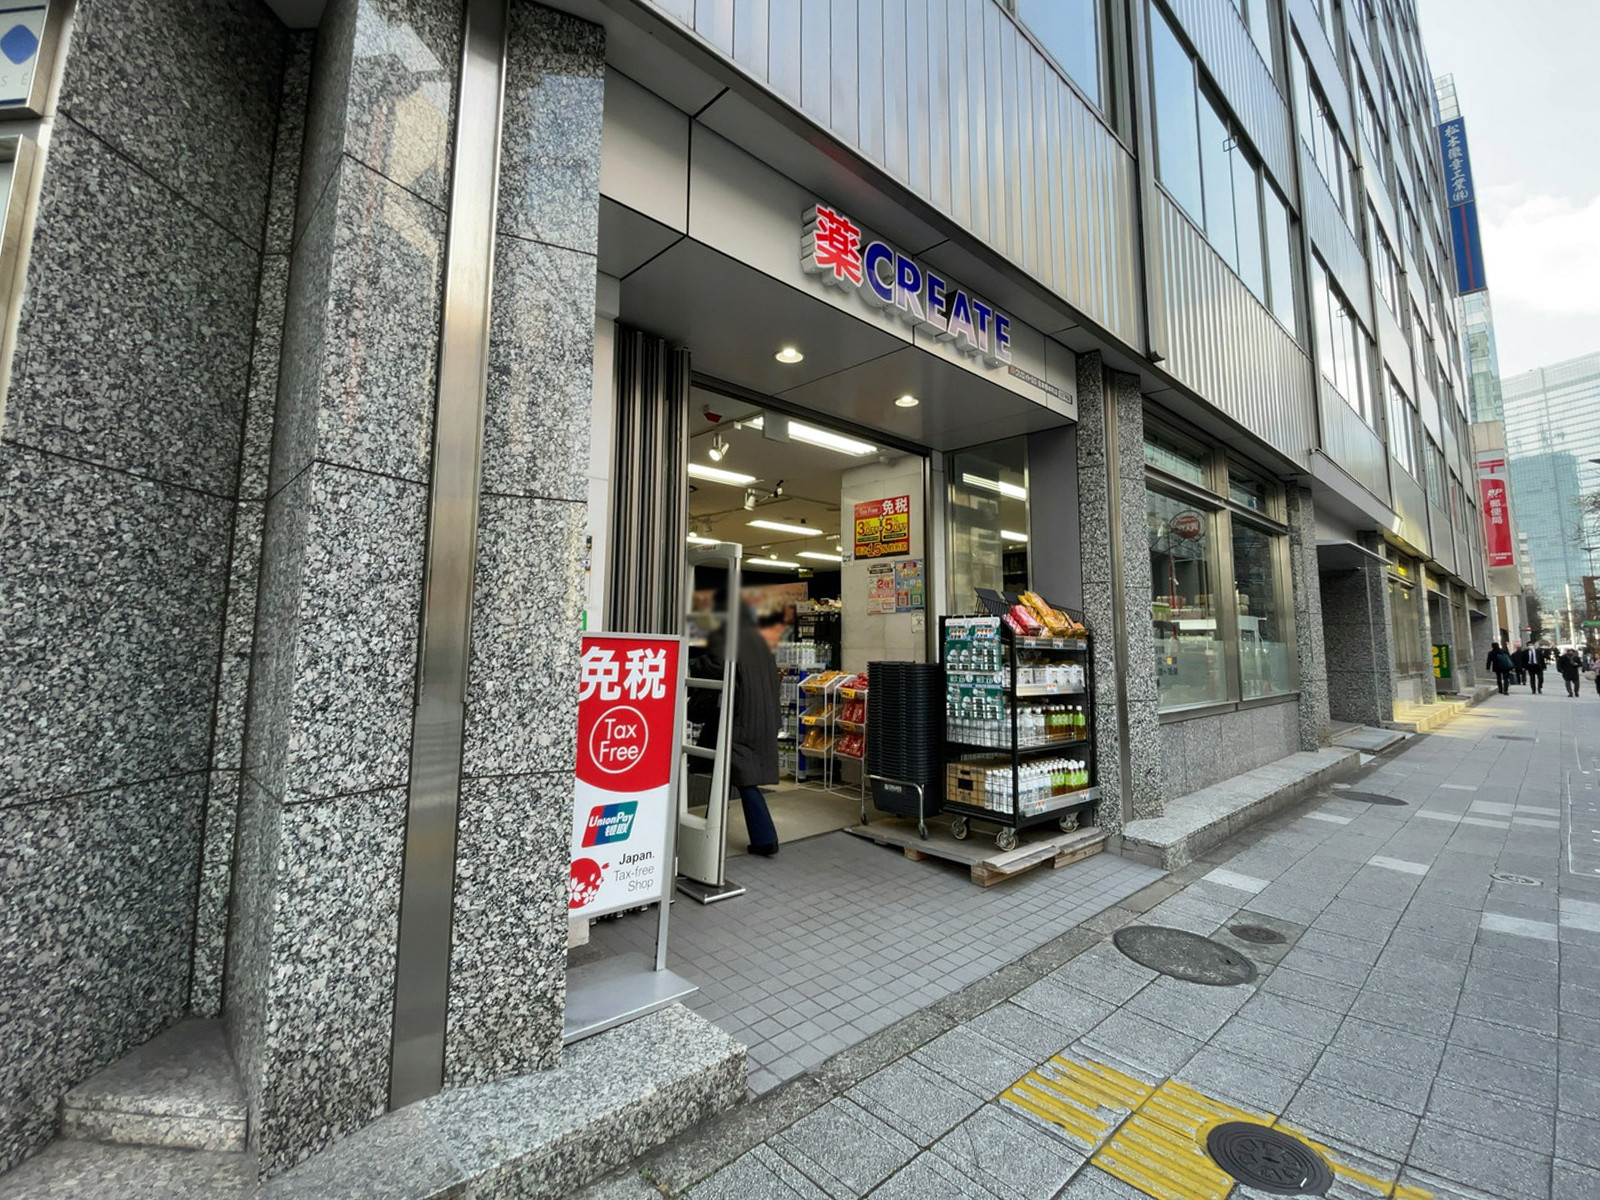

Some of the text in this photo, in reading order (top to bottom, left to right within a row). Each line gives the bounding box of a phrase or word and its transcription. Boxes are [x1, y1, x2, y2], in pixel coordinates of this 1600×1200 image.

[815, 203, 1012, 366] 薬 CREATE
[882, 497, 908, 516] 免税
[578, 645, 667, 702] 免税
[604, 718, 638, 740] Tax
[599, 740, 639, 763] Free
[588, 811, 634, 828] UnionPay
[619, 851, 655, 865] Japan.
[614, 865, 655, 882] Tax-free
[627, 878, 654, 892] Shop
